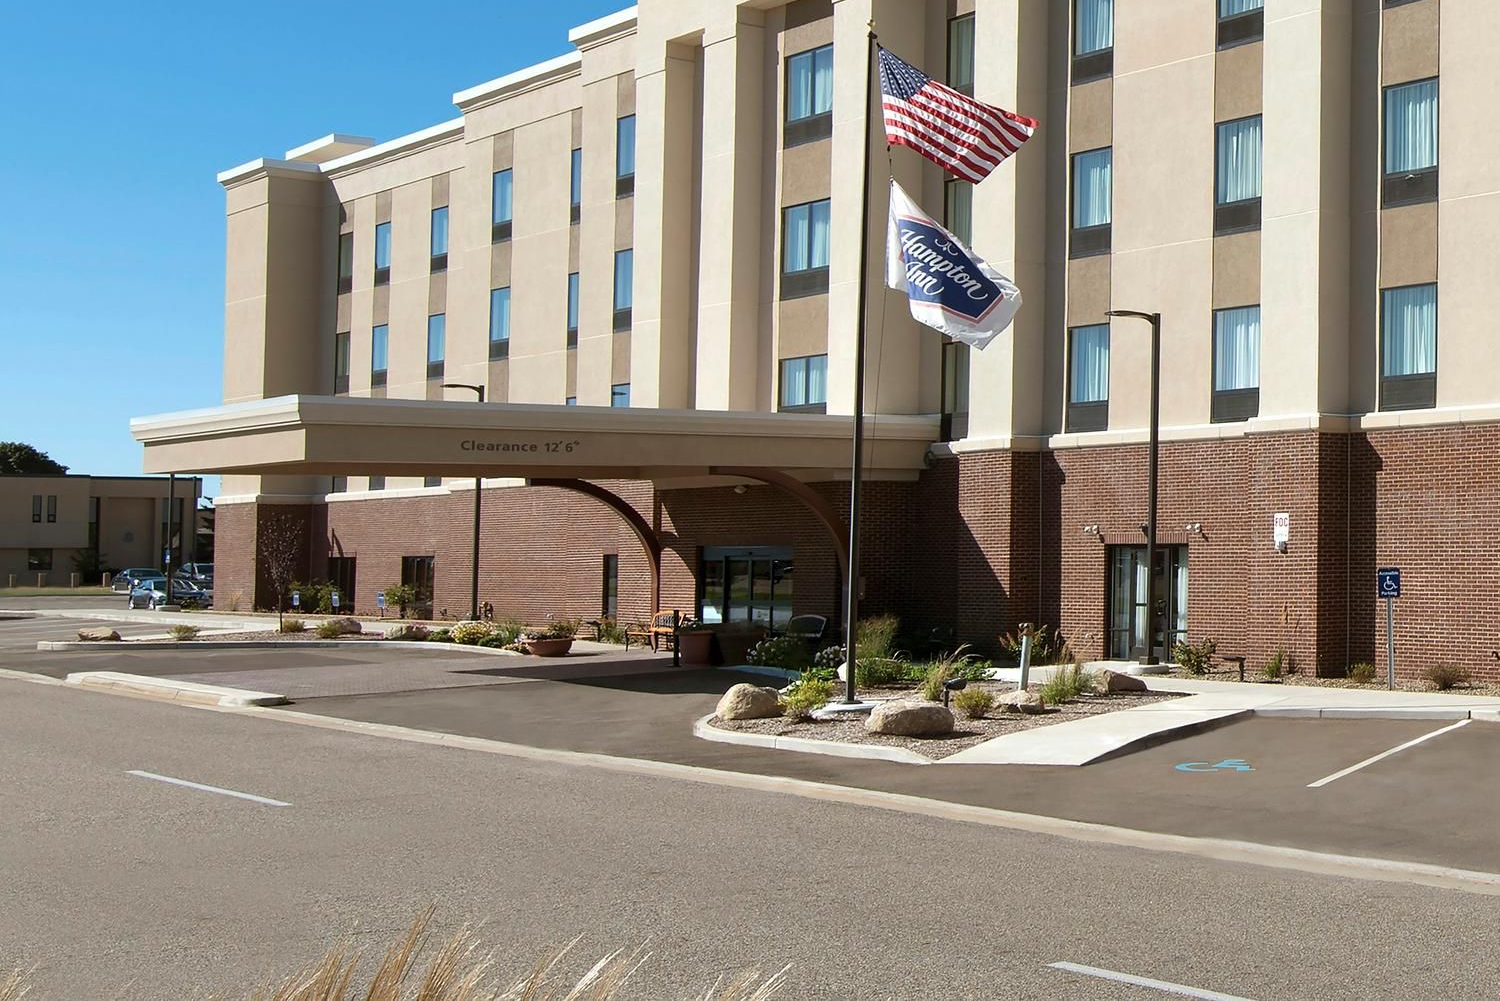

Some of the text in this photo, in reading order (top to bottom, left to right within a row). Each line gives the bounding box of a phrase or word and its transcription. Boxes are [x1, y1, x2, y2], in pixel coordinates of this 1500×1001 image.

[900, 229, 988, 300] Hampton
[905, 261, 945, 296] Inn
[460, 440, 538, 452] Clearance
